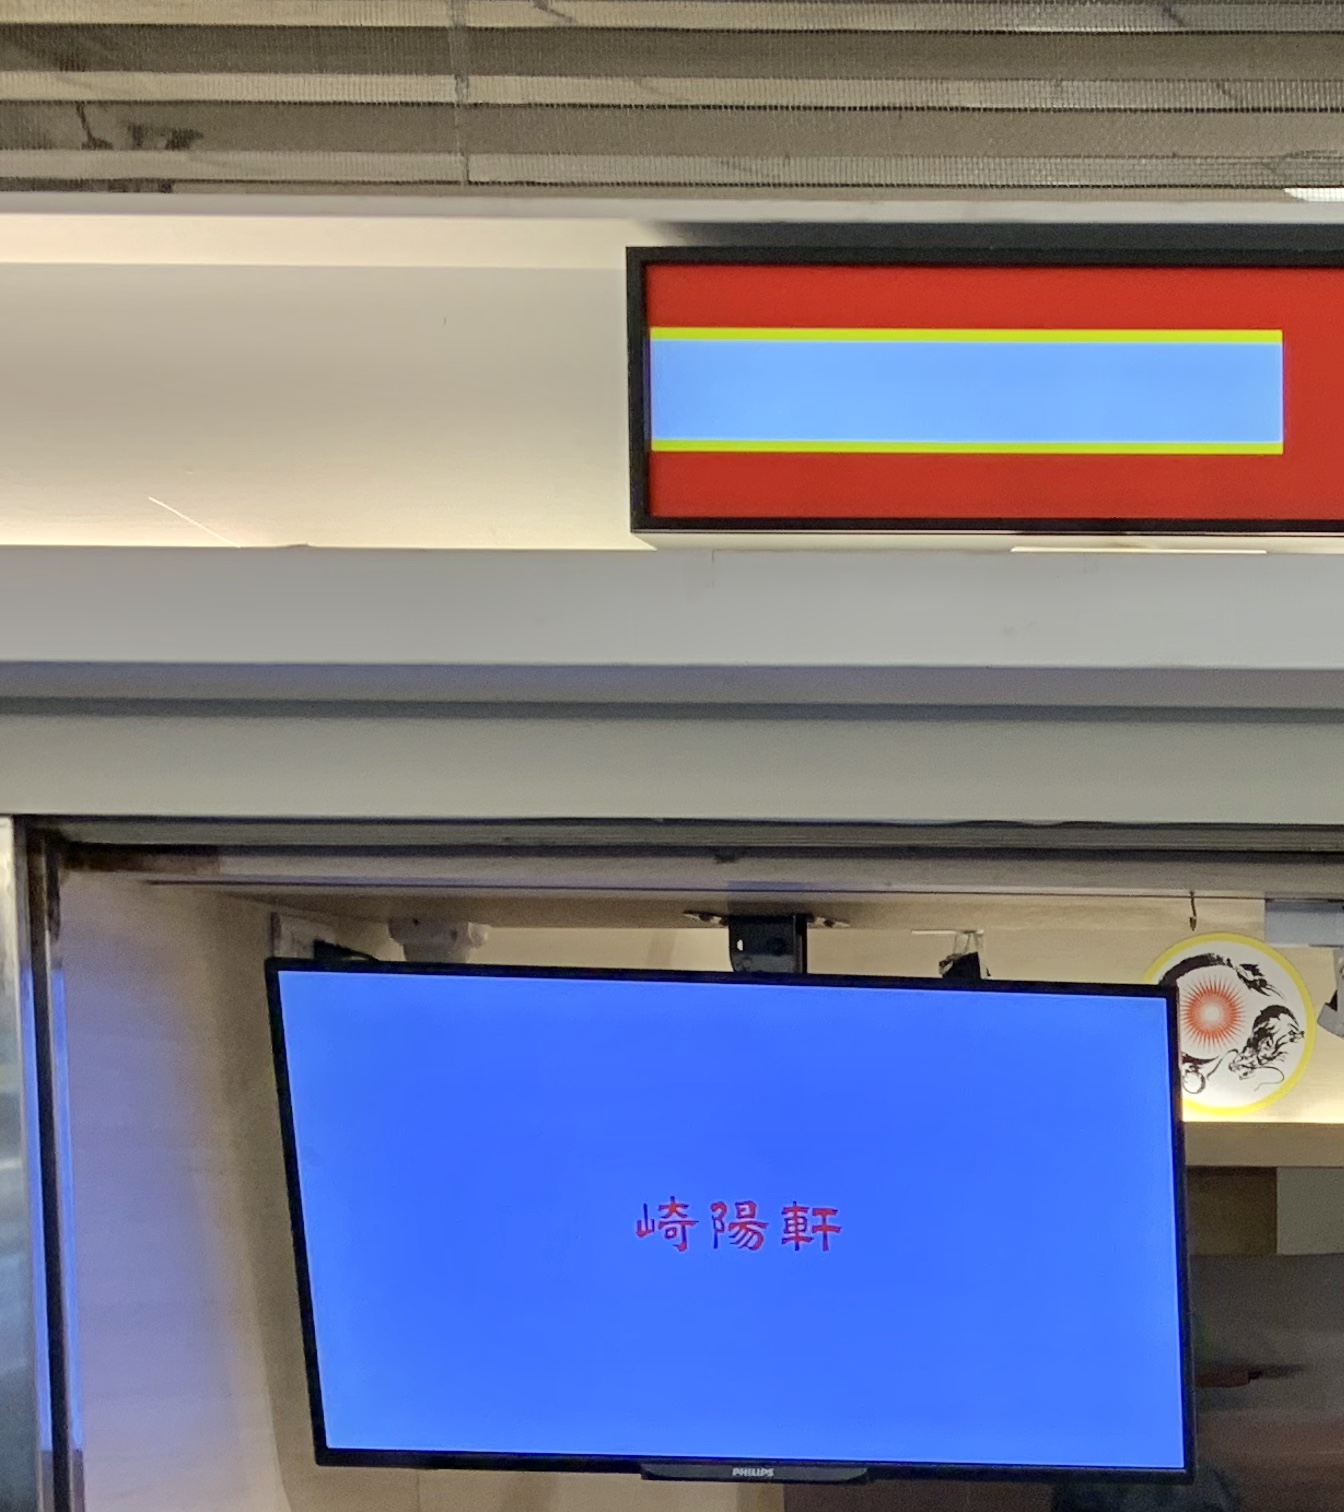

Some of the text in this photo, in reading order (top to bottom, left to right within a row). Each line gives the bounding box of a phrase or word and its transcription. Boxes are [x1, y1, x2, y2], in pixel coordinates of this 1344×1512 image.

[635, 1196, 843, 1252] 崎陽軒
[731, 1467, 775, 1478] PHILIPS
